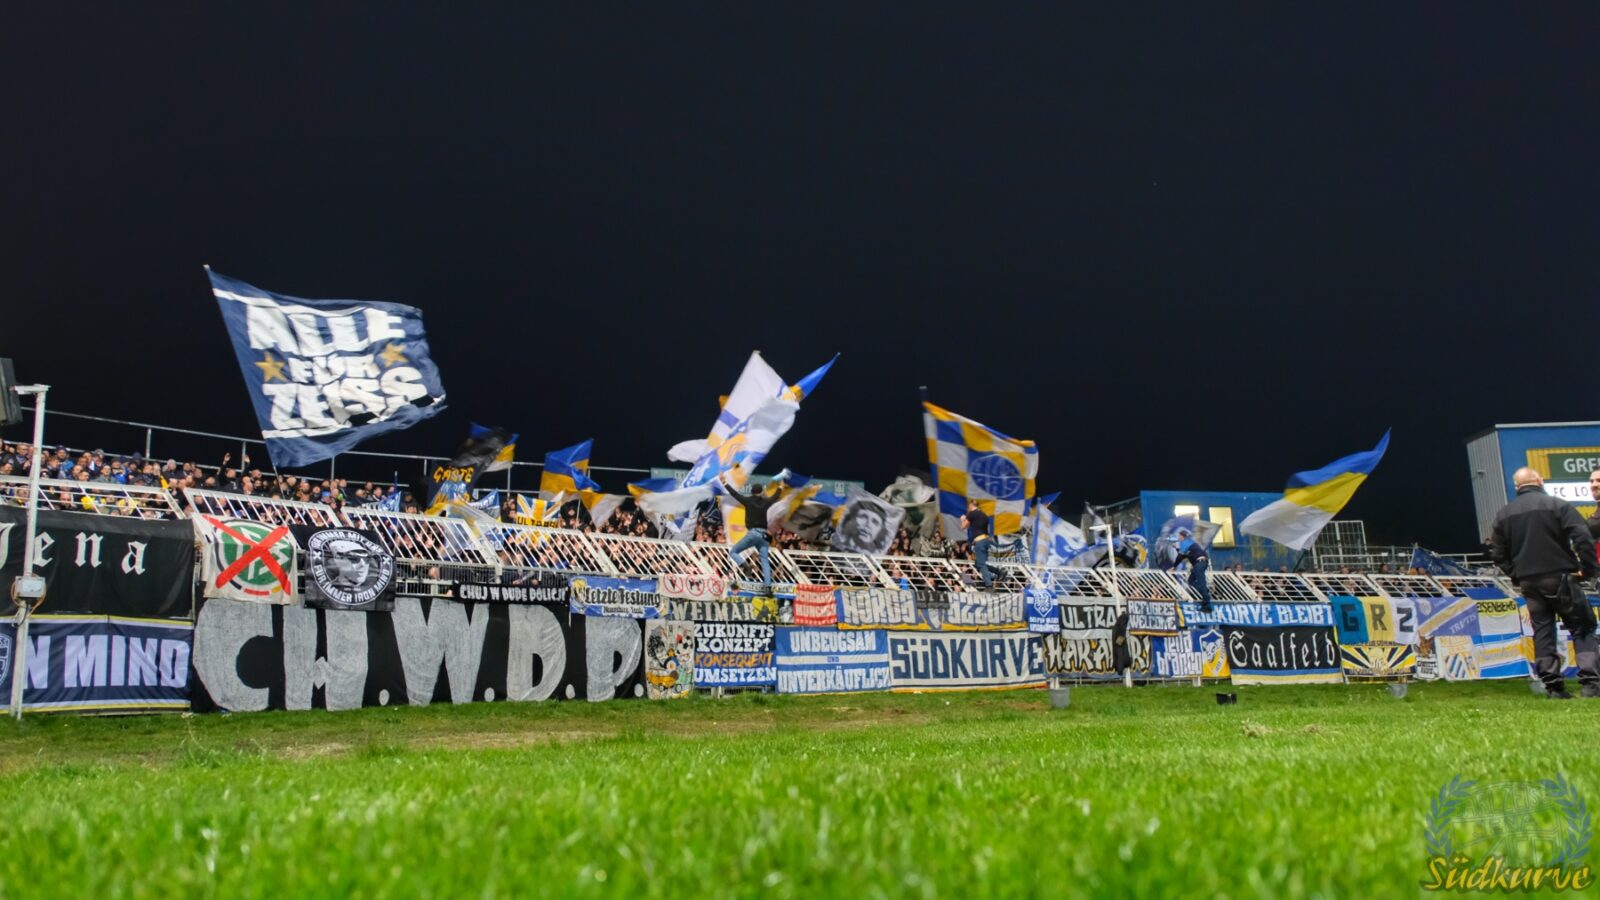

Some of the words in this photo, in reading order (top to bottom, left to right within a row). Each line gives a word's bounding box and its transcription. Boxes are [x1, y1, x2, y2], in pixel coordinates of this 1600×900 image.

[246, 303, 406, 358] ALLE
[1563, 458, 1600, 473] GRE
[322, 582, 353, 603] IMMER
[354, 588, 376, 602] IRON
[373, 568, 390, 592] MIND
[460, 584, 488, 600] CHUJ
[489, 586, 500, 600] W
[585, 586, 618, 604] Letzte
[671, 601, 756, 621] WEIMAR
[1128, 600, 1175, 615] REFUGEES
[1277, 603, 1333, 625] BLEIBT
[1476, 601, 1516, 613] EISENBERG
[1061, 605, 1127, 629] ULTRA
[1129, 615, 1177, 630] WELCOME
[694, 623, 774, 638] ZUKUNFTS
[696, 637, 771, 653] KONZEPT
[789, 631, 876, 653] UNBEUGSAM
[1229, 630, 1335, 670] Saalfeld
[64, 635, 189, 688] MIND
[695, 652, 774, 668] KONSEQUENT
[890, 636, 1044, 680] SÜDKURVE
[694, 667, 777, 682] UMSETZEN
